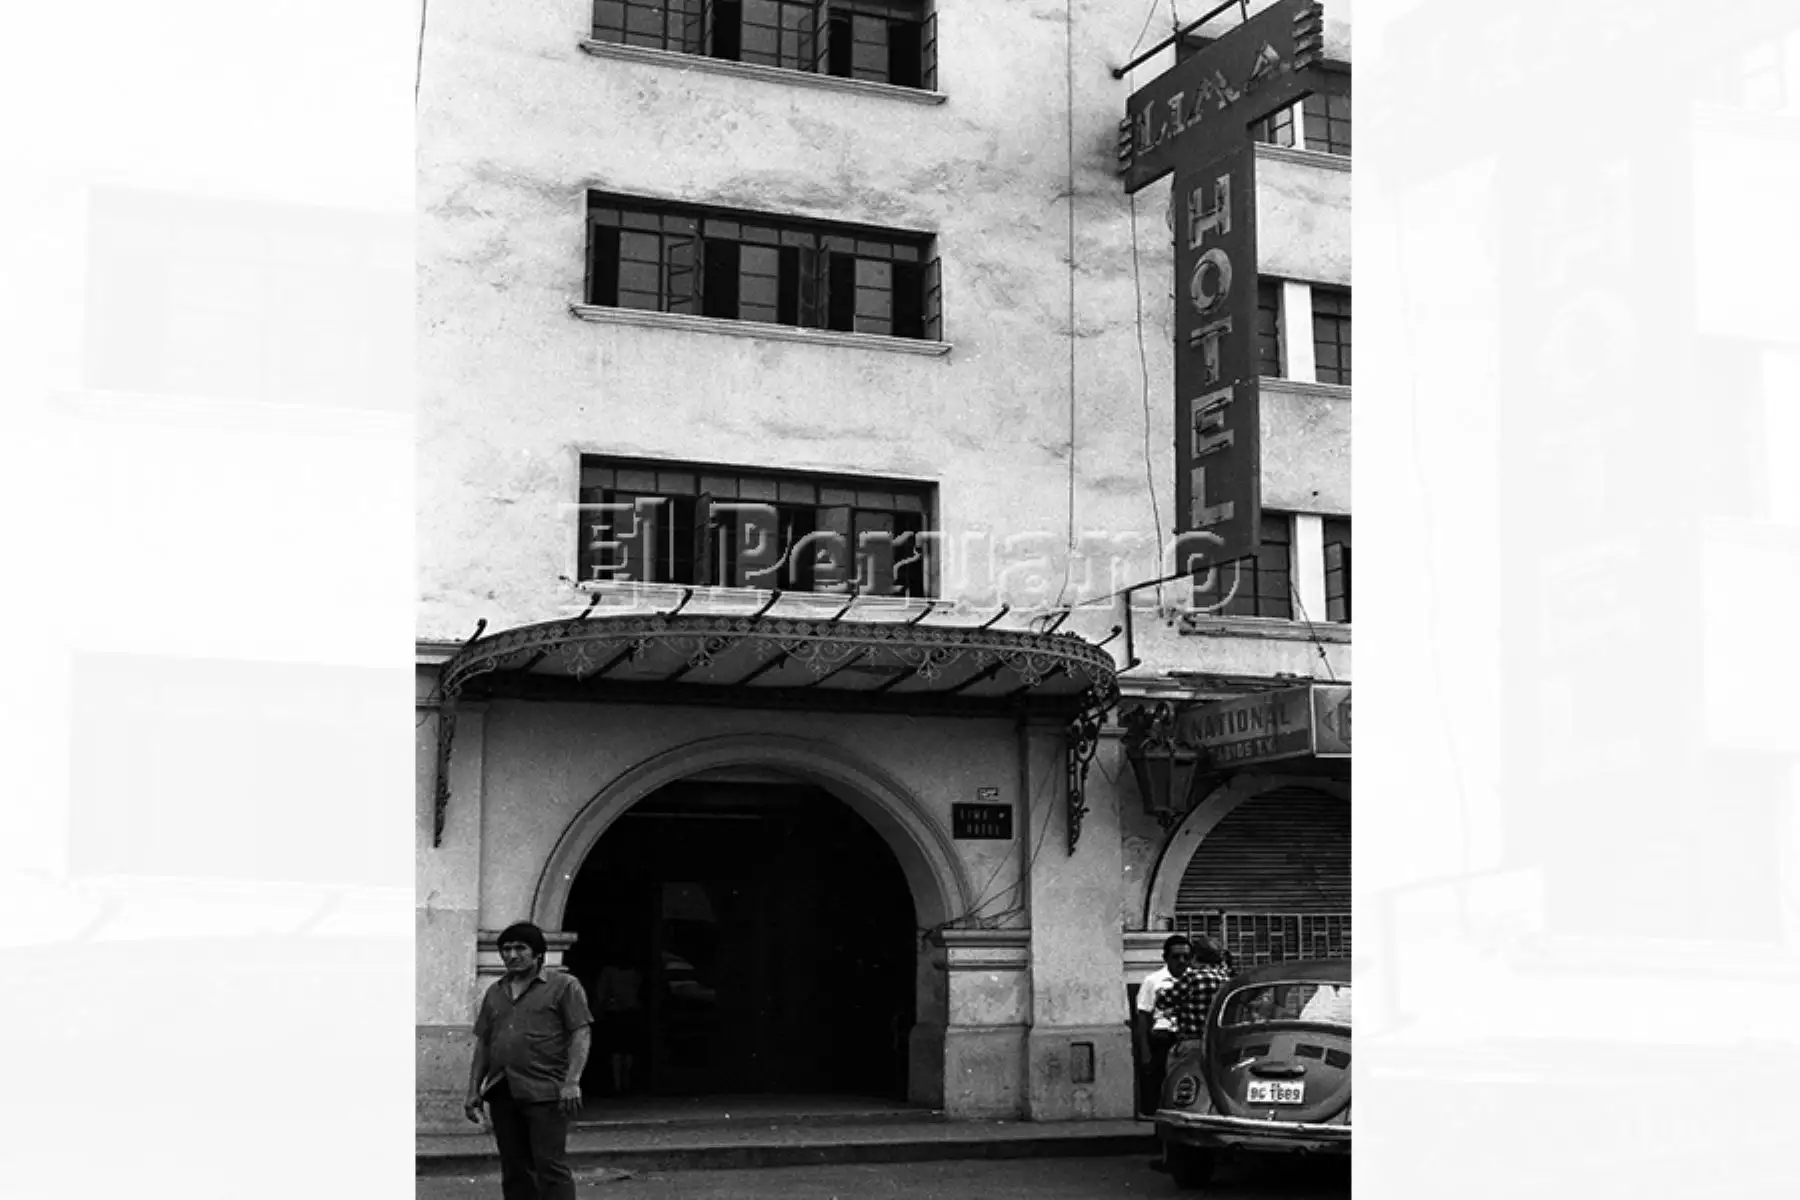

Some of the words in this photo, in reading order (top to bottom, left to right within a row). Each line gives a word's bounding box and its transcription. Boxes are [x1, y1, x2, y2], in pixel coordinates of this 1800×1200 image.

[1136, 40, 1289, 156] LIMA
[1188, 173, 1233, 529] HOTEL
[1190, 702, 1290, 741] NATIONAL
